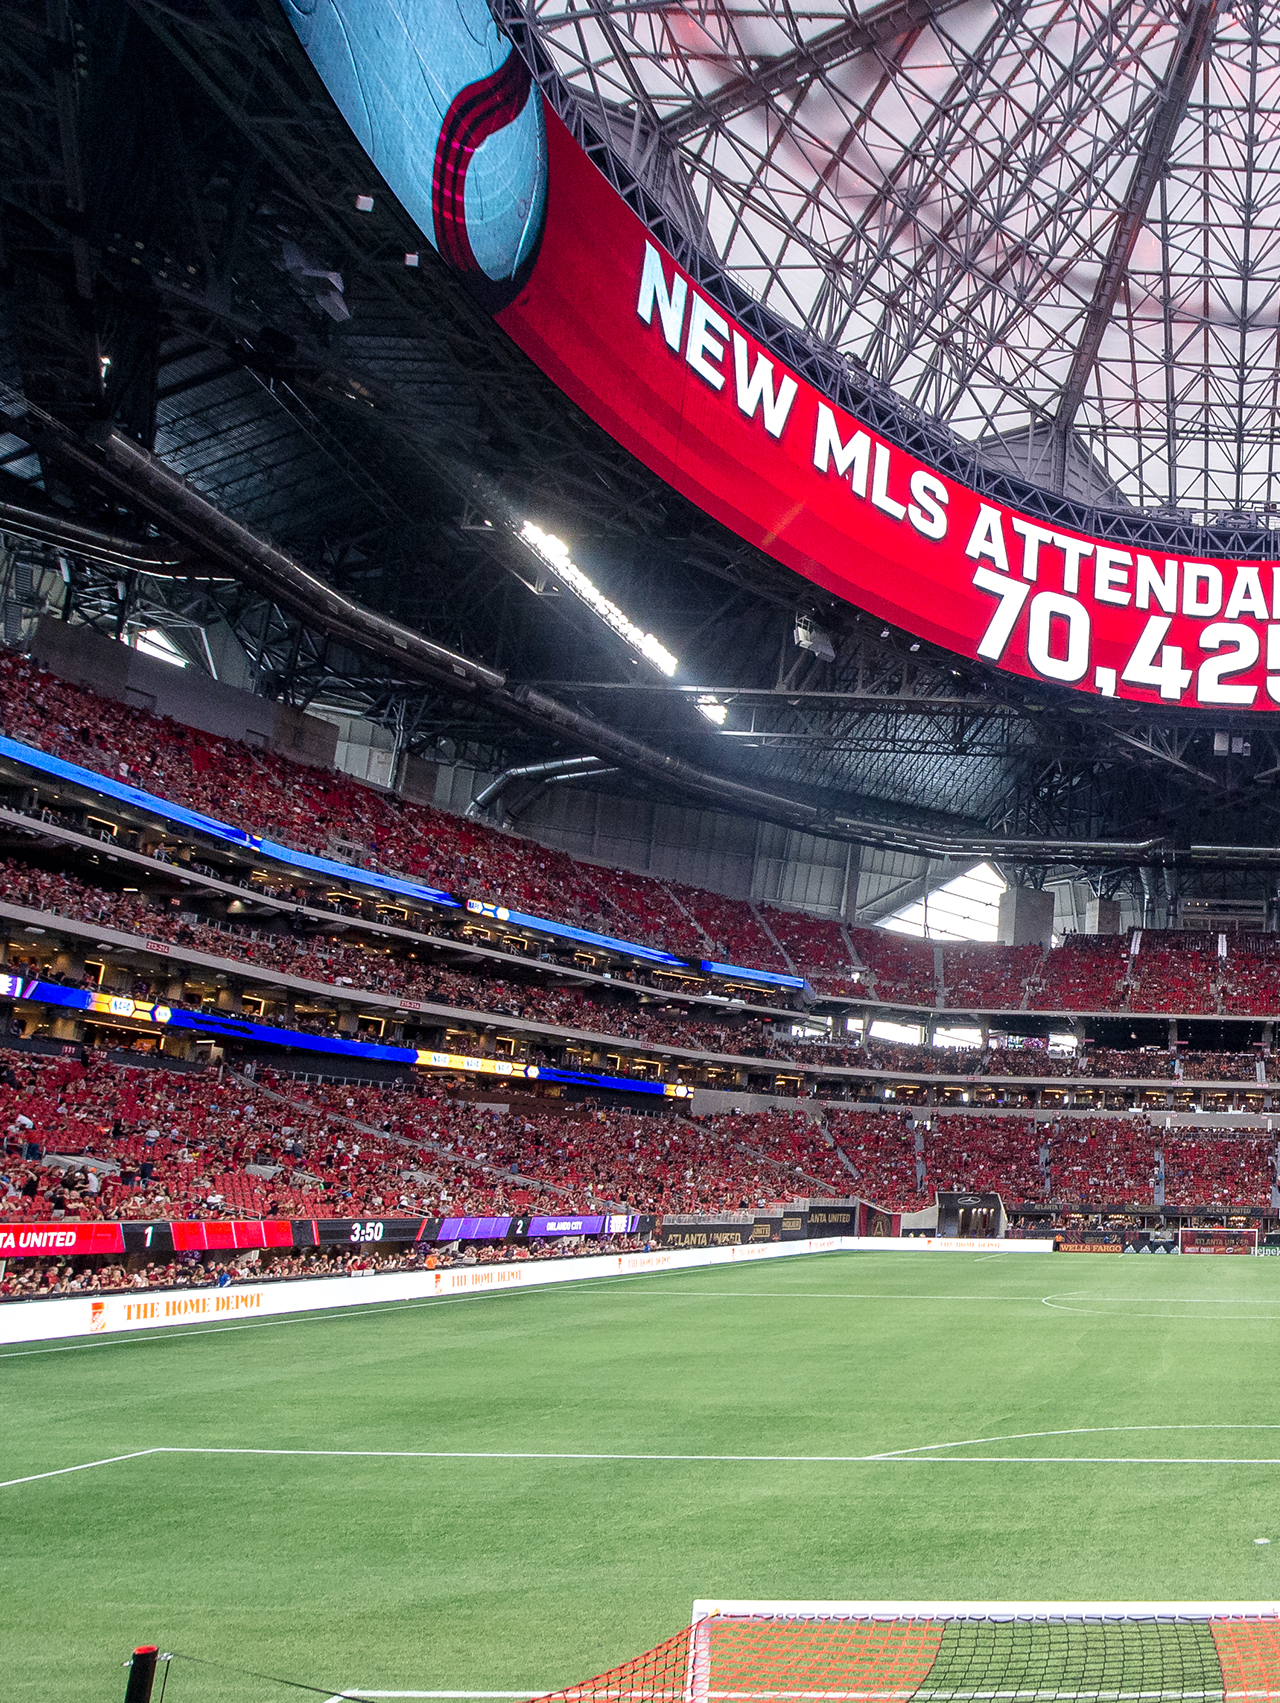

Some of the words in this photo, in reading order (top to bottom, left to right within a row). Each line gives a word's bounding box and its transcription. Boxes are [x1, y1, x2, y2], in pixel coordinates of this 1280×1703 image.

[636, 240, 798, 438] NEW
[813, 401, 949, 541] MLS
[516, 1219, 524, 1234] 2
[808, 1213, 827, 1223] ANTA
[828, 1213, 851, 1222] UNITED
[18, 1232, 76, 1249] UNITED
[144, 1226, 154, 1248] 1
[350, 1222, 384, 1242] 3:50
[668, 1233, 707, 1246] ATLANTA
[1060, 1244, 1091, 1252] WELLS
[1092, 1244, 1122, 1252] FARGO
[452, 1275, 469, 1287] THE
[471, 1272, 494, 1285] HOME
[497, 1270, 522, 1282] DEPOT
[124, 1302, 160, 1321] THE
[165, 1298, 211, 1317] HOME
[215, 1292, 265, 1312] DEPOT
